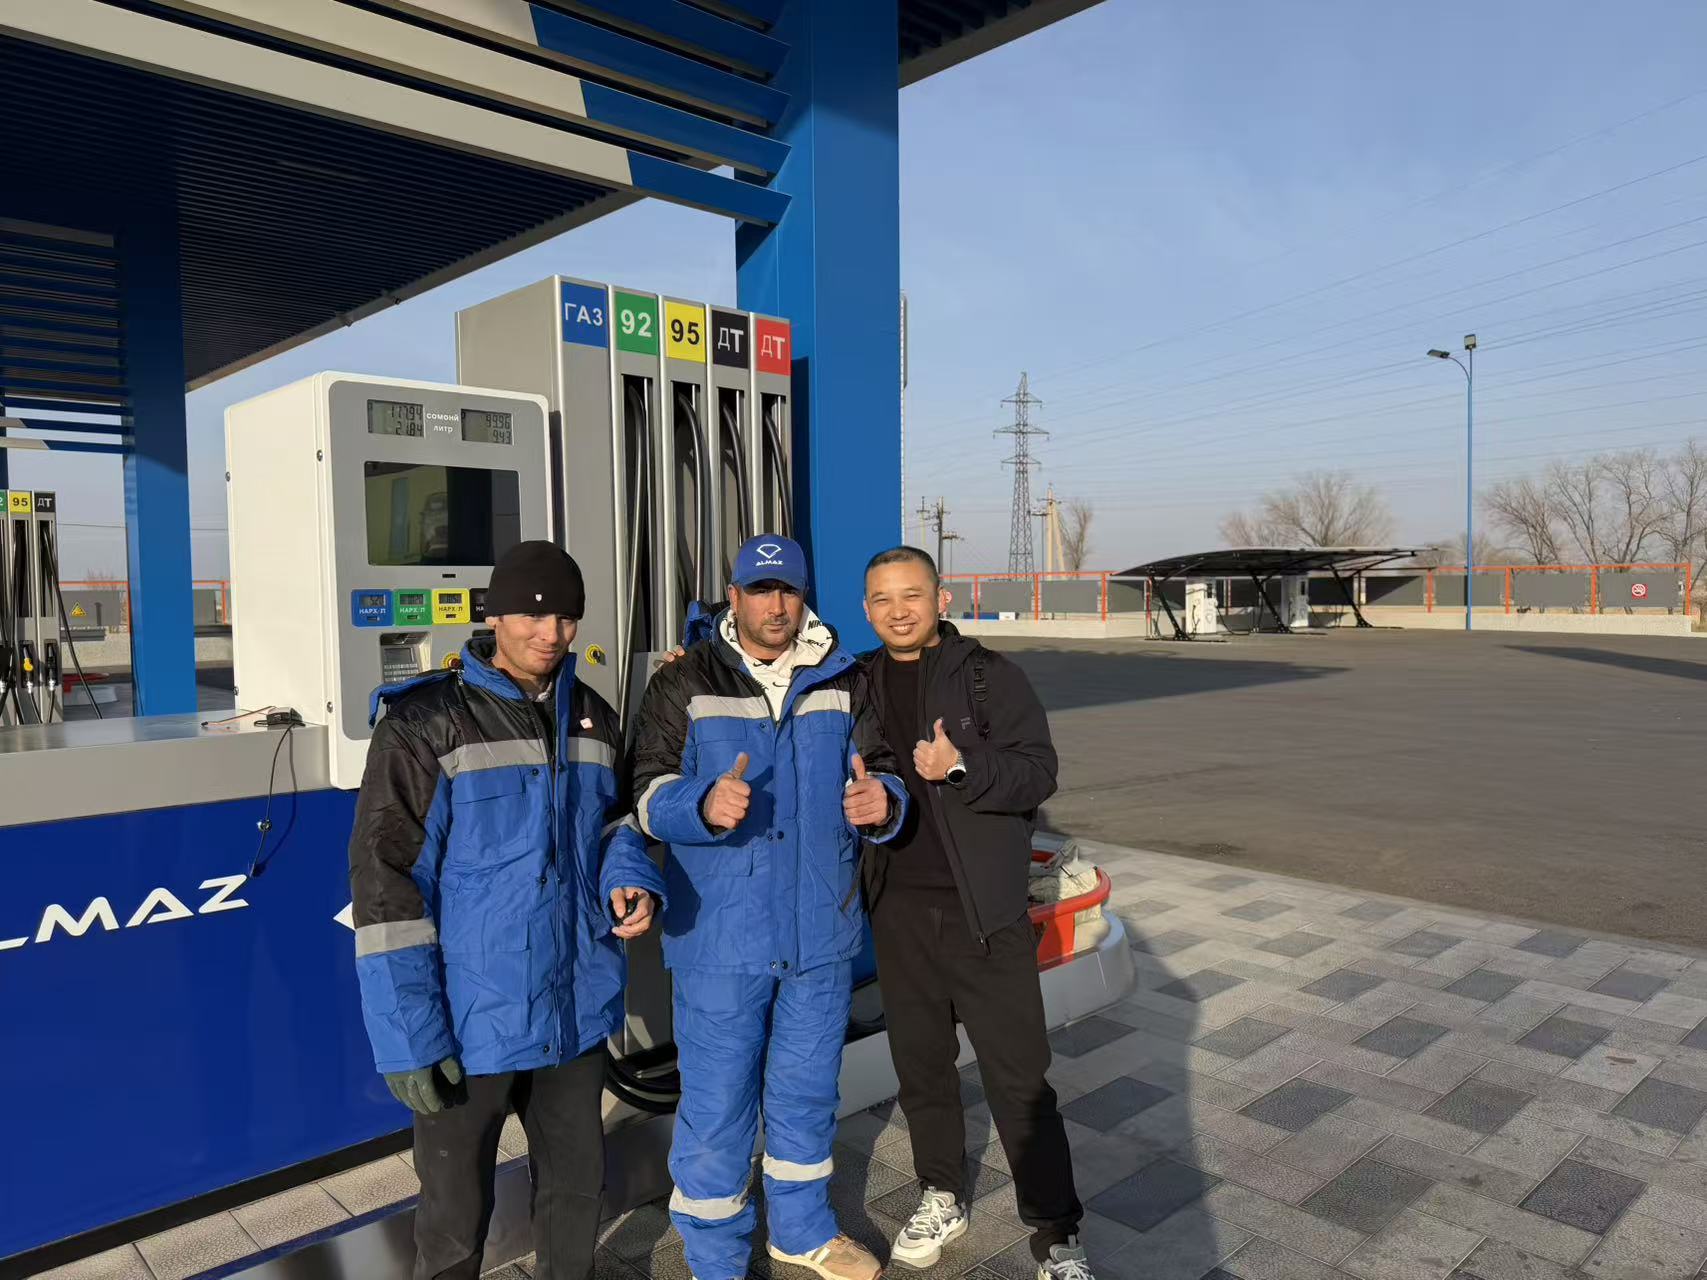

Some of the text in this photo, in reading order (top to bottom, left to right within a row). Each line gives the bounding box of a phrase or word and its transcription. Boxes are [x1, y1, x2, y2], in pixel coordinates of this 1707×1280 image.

[565, 302, 604, 327] ГАЗ
[621, 309, 652, 338] 92
[671, 319, 701, 346] 95
[717, 327, 744, 353] ДТ
[761, 335, 786, 360] ДТ
[13, 497, 28, 506] 95
[38, 498, 53, 508] ДТ
